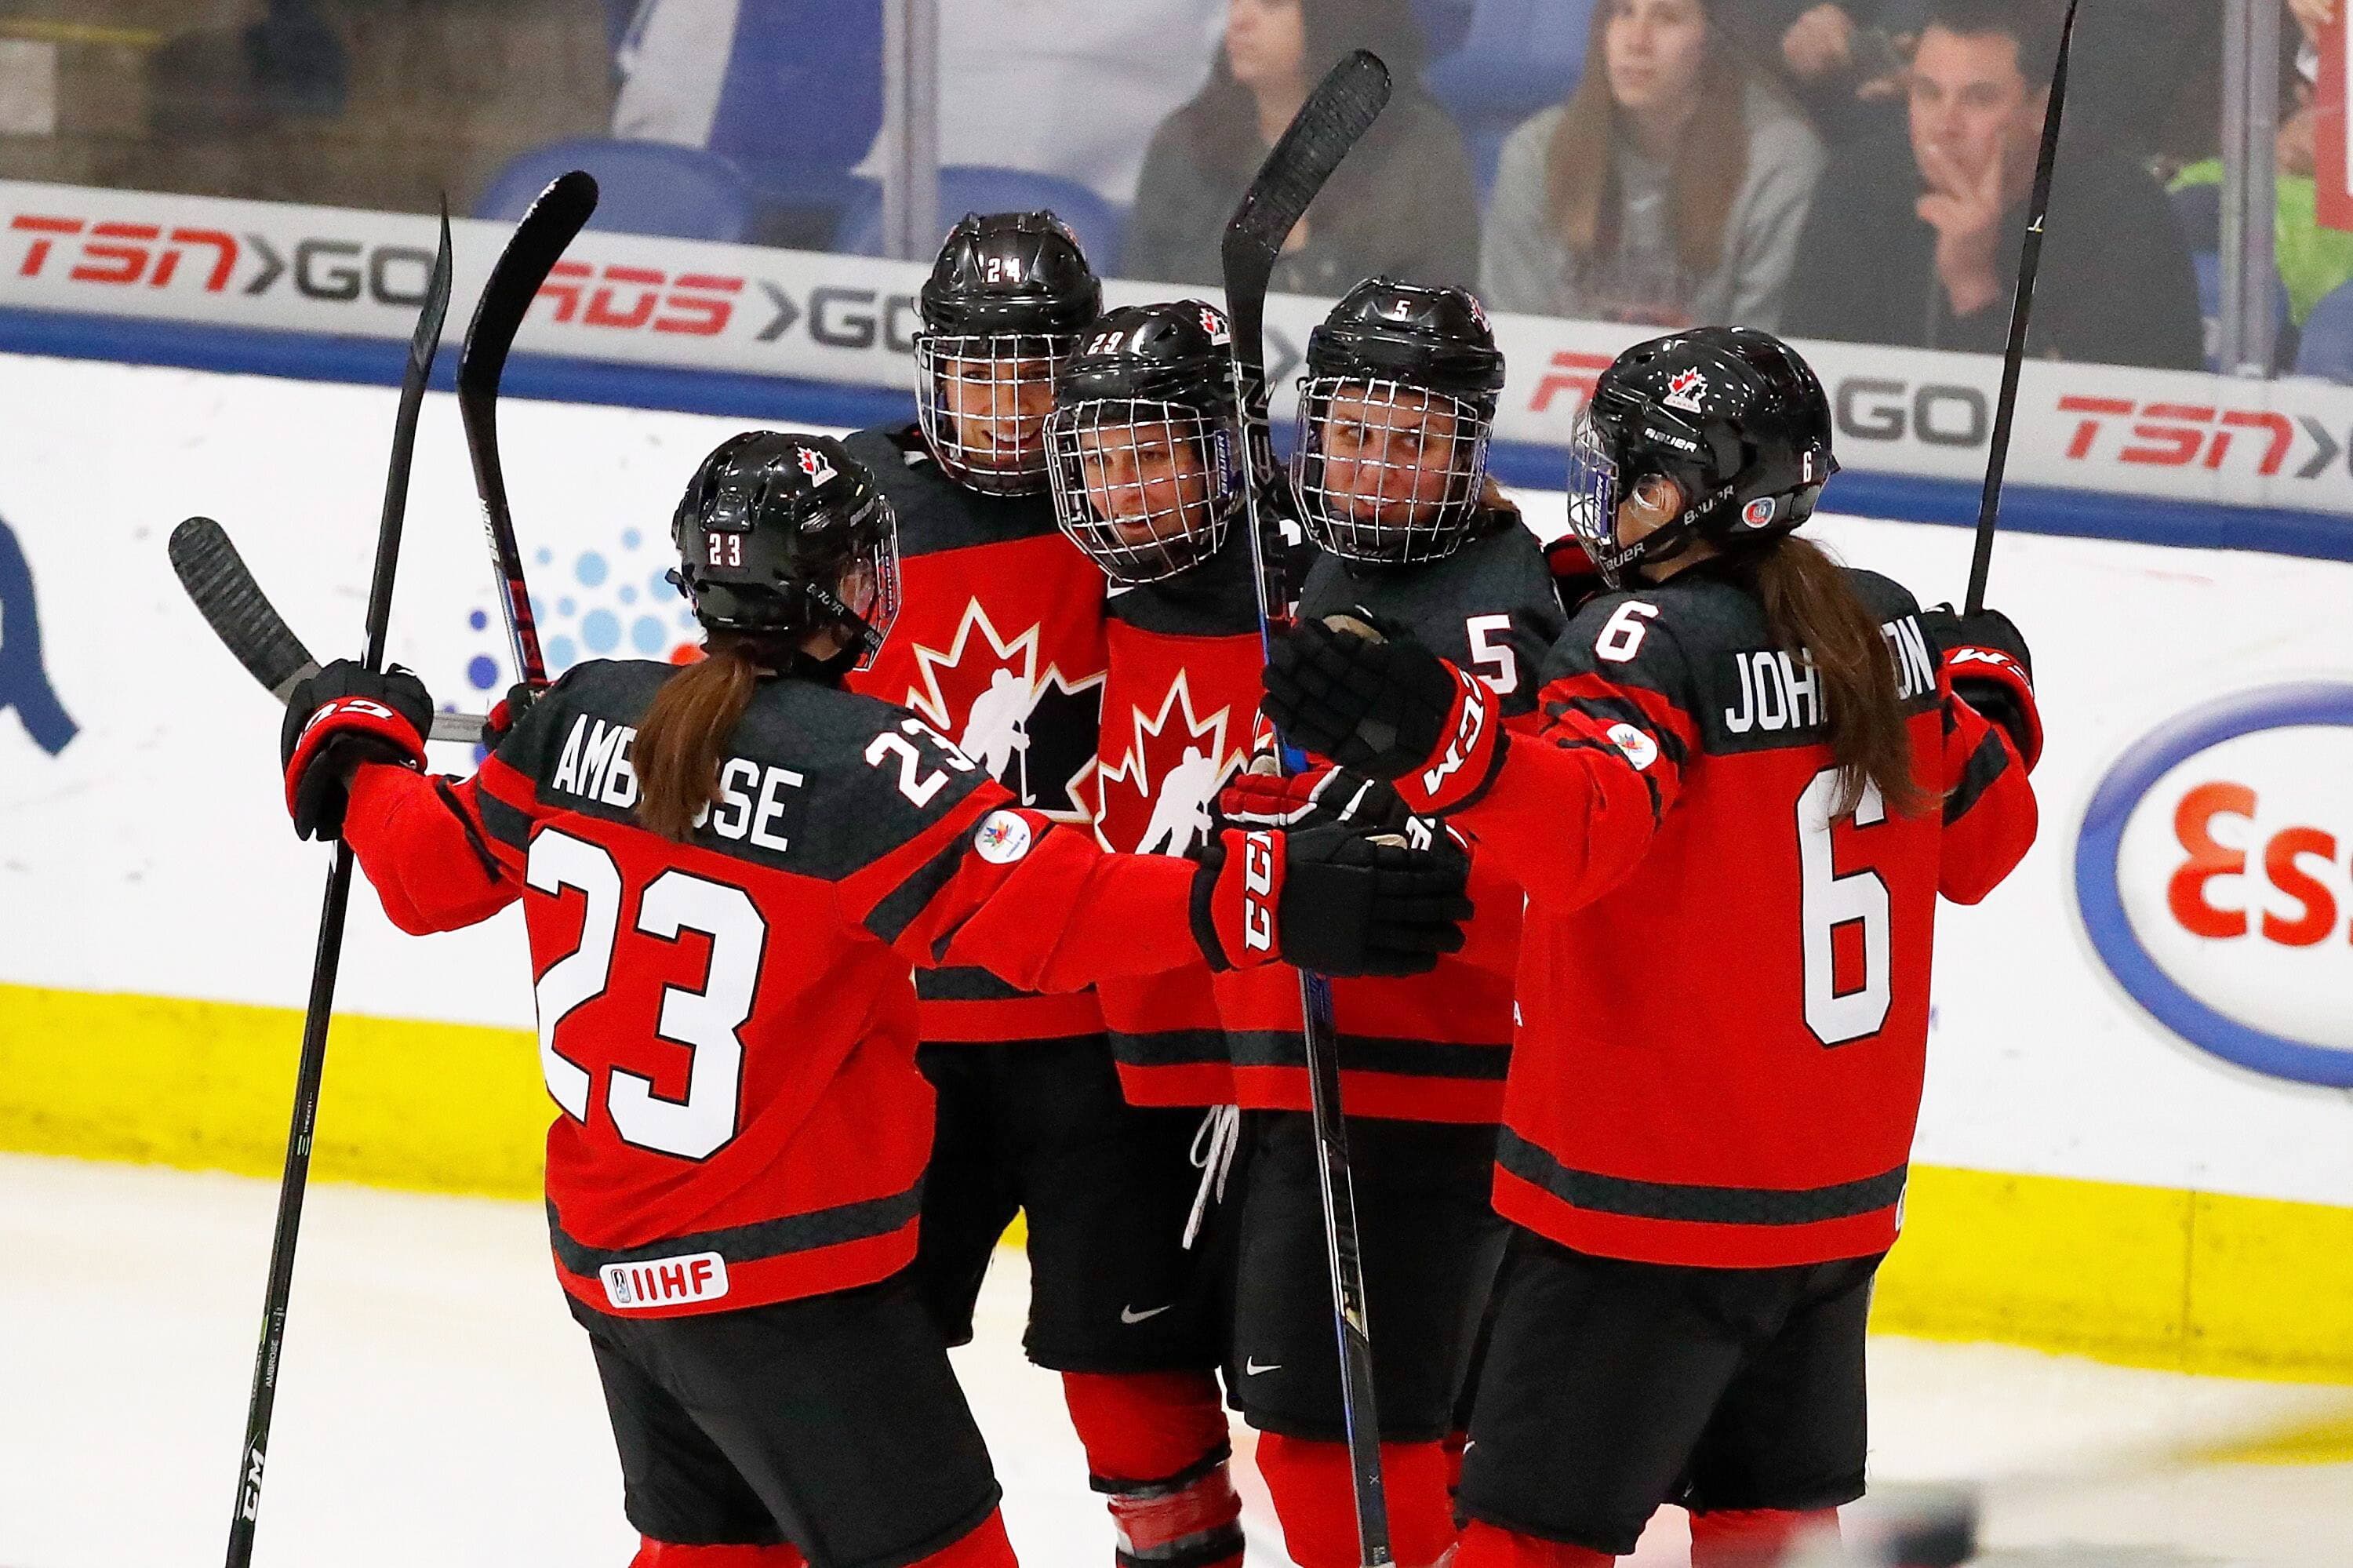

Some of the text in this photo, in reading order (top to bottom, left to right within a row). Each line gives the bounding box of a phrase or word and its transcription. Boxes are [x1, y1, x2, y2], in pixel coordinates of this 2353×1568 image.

[9, 215, 238, 293] TSN
[987, 257, 1020, 282] 24
[1087, 331, 1124, 355] 29
[1393, 300, 1411, 322] 5
[1836, 377, 1988, 449] GO
[2058, 395, 2294, 476] TSN
[1803, 451, 1813, 482] 6
[708, 532, 742, 567] 23
[1466, 614, 1518, 694] 5
[1595, 600, 1660, 663] 6
[551, 713, 804, 853] AMBSE
[865, 718, 976, 809] 23
[1796, 766, 1893, 1046] 6
[526, 827, 769, 1160] 23
[632, 1259, 713, 1301] IIHF
[265, 1339, 279, 1388] AMBROSE
[242, 1447, 265, 1522] CM
